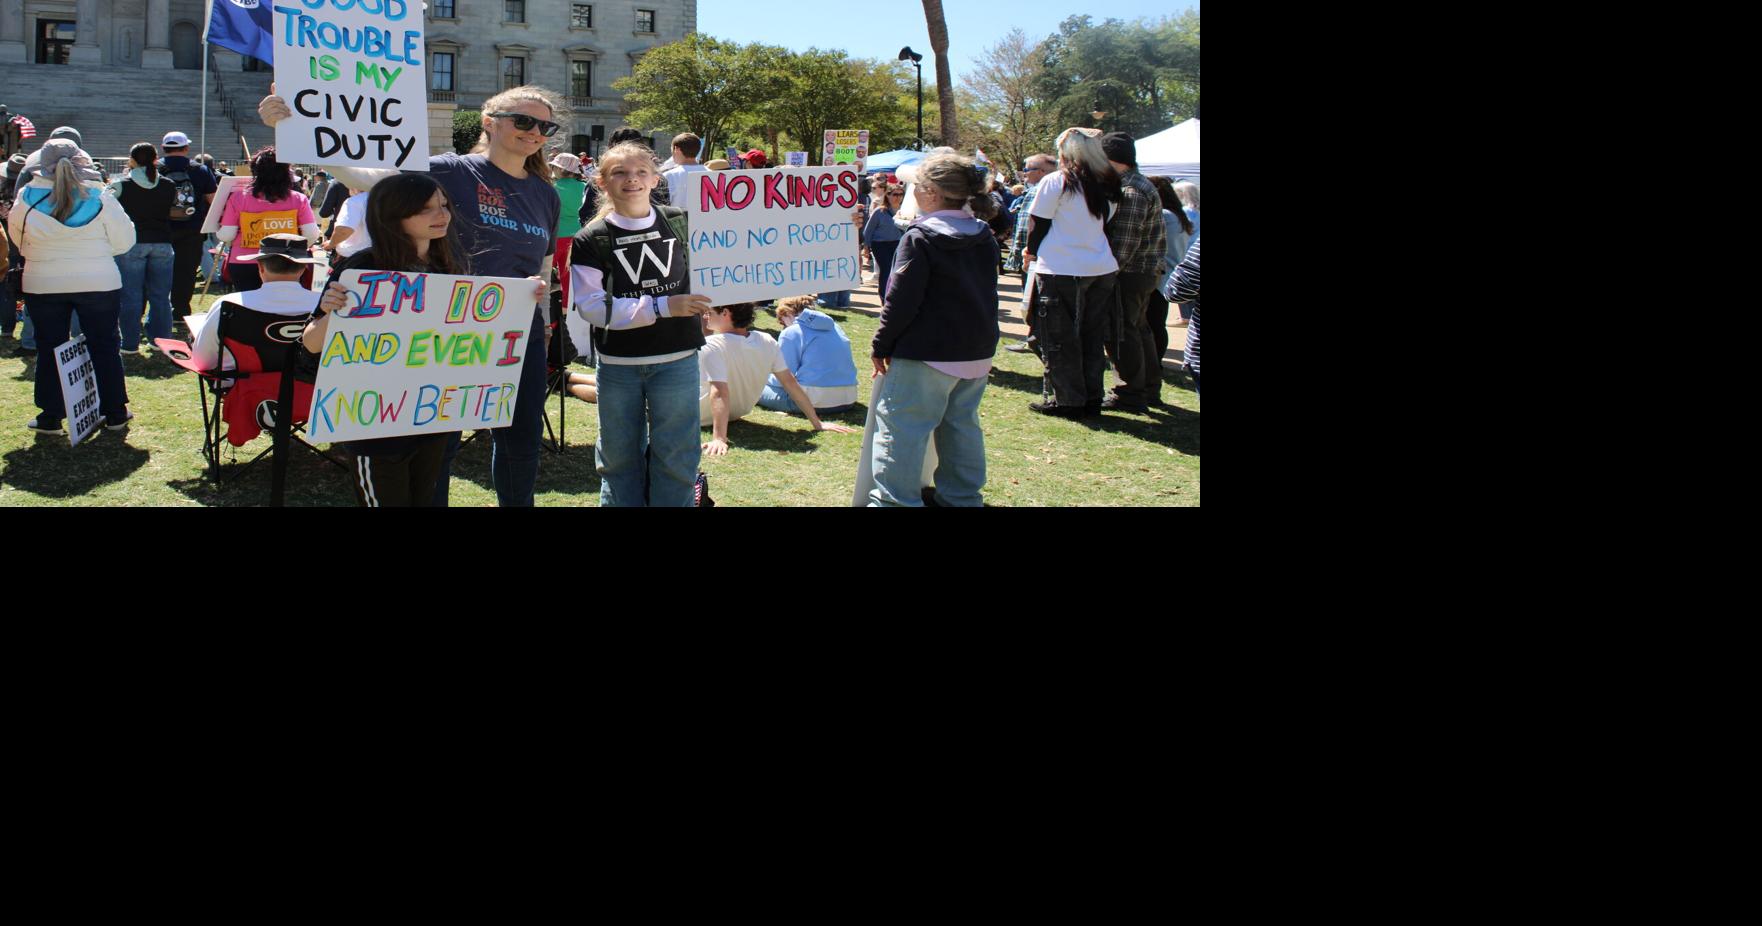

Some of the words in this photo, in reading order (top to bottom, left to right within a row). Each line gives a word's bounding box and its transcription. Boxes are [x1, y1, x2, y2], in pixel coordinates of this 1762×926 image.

[274, 5, 421, 65] TROUBLE
[310, 55, 341, 81] IS
[355, 61, 402, 92] MY
[294, 89, 402, 127] CIVIC
[315, 127, 415, 168] DUTY
[478, 193, 508, 208] ROE
[700, 173, 756, 212] NO
[763, 170, 858, 210] KINGS
[264, 219, 294, 230] LOVE
[479, 204, 507, 218] ROE
[480, 213, 518, 231] YOUR
[691, 229, 738, 252] (AND
[747, 225, 778, 249] NO
[788, 223, 853, 246] ROBOT
[613, 238, 677, 285] W
[693, 262, 785, 287] TEACHERS
[790, 256, 857, 282] EITHER)
[350, 271, 428, 318] I'M
[445, 280, 505, 323] 10
[60, 341, 87, 365] RESPEC
[322, 331, 400, 368] AND
[405, 329, 494, 368] EVEN
[496, 331, 523, 366] I
[84, 376, 95, 392] OR
[73, 391, 97, 418] EXPECT
[311, 387, 407, 436] KNOW
[413, 383, 516, 426] BETTER
